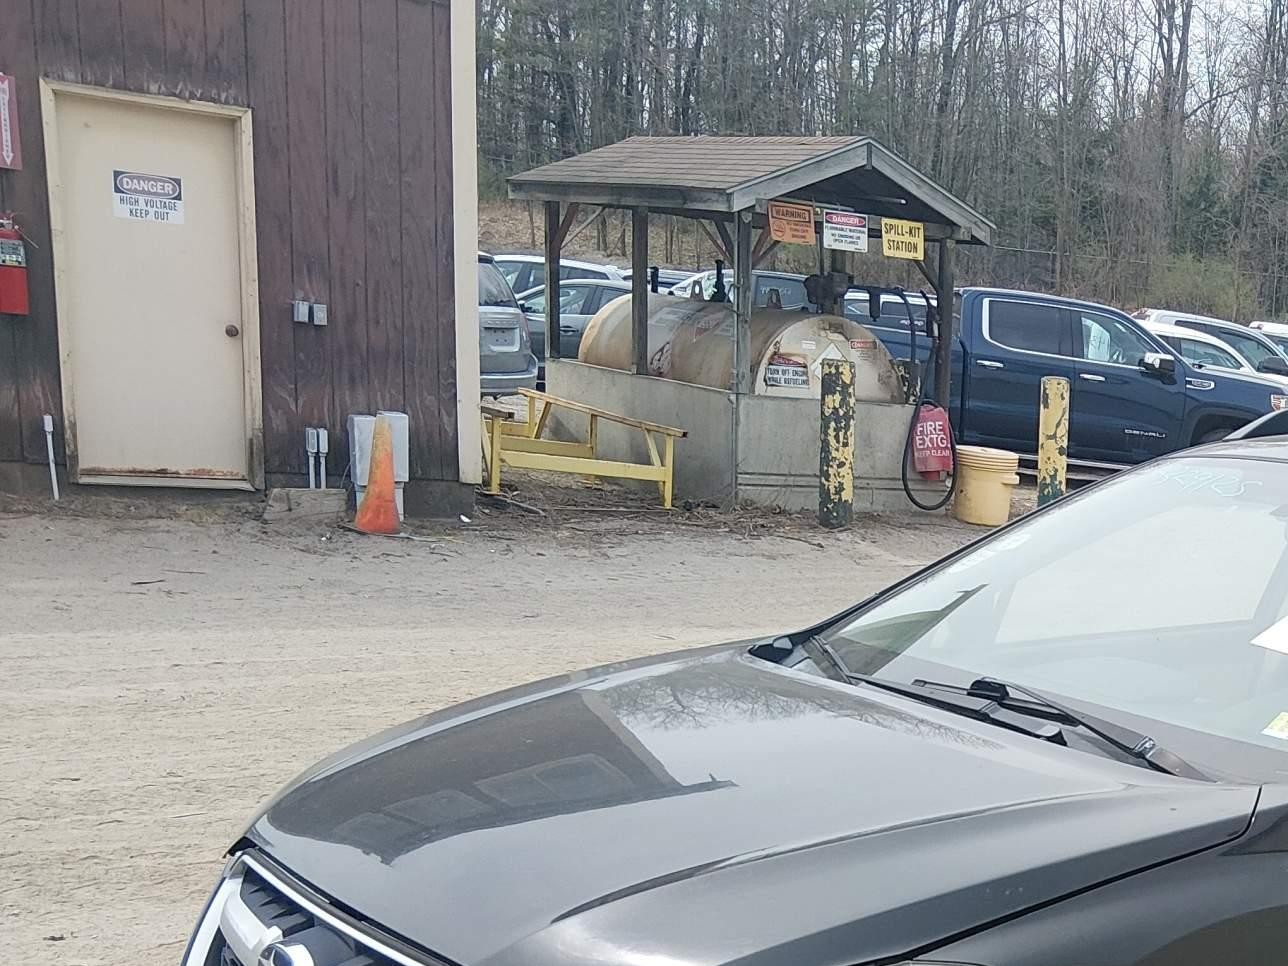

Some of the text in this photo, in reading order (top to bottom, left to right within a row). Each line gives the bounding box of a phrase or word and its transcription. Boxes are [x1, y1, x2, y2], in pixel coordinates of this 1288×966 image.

[122, 178, 173, 194] DANGER
[119, 196, 177, 211] HIGH VOLTAGE
[129, 208, 170, 221] KEEP OUT
[774, 206, 807, 220] WARNING
[832, 215, 859, 225] DANGER
[884, 222, 921, 238] SPILL-KIT
[887, 239, 918, 254] STATION
[767, 367, 780, 376] TURN
[916, 421, 944, 435] FIRE
[932, 449, 950, 457] CLEAR
